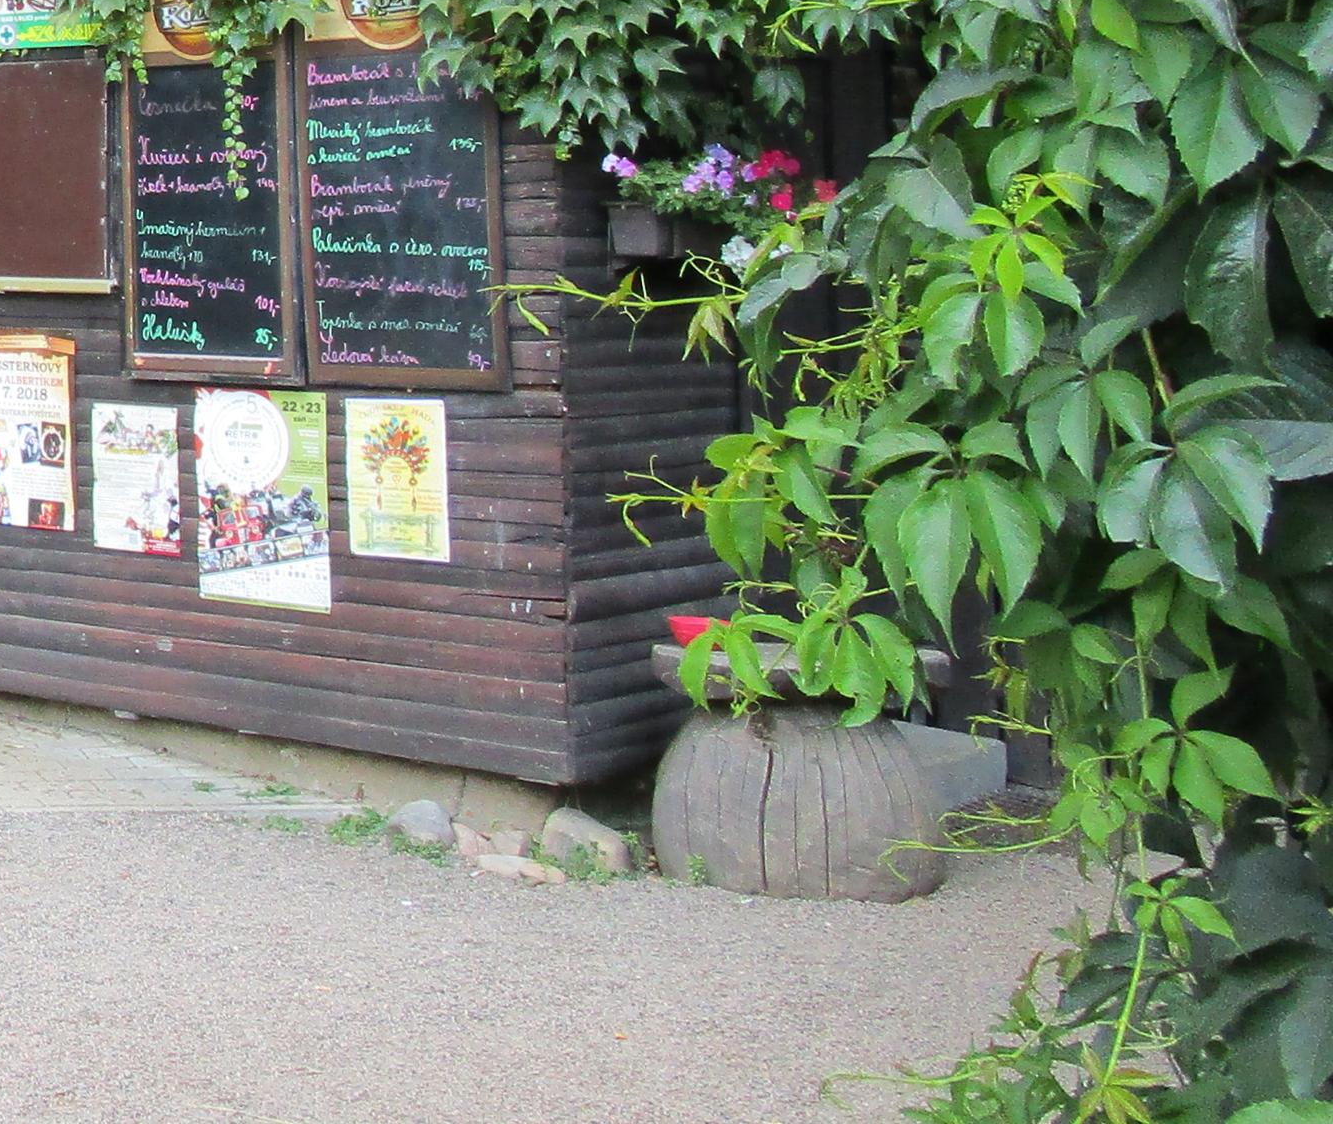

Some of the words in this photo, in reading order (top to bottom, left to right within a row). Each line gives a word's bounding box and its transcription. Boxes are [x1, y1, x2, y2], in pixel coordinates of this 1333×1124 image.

[161, 4, 211, 31] Koz
[141, 312, 206, 351] Halušky
[16, 386, 49, 402] 2018
